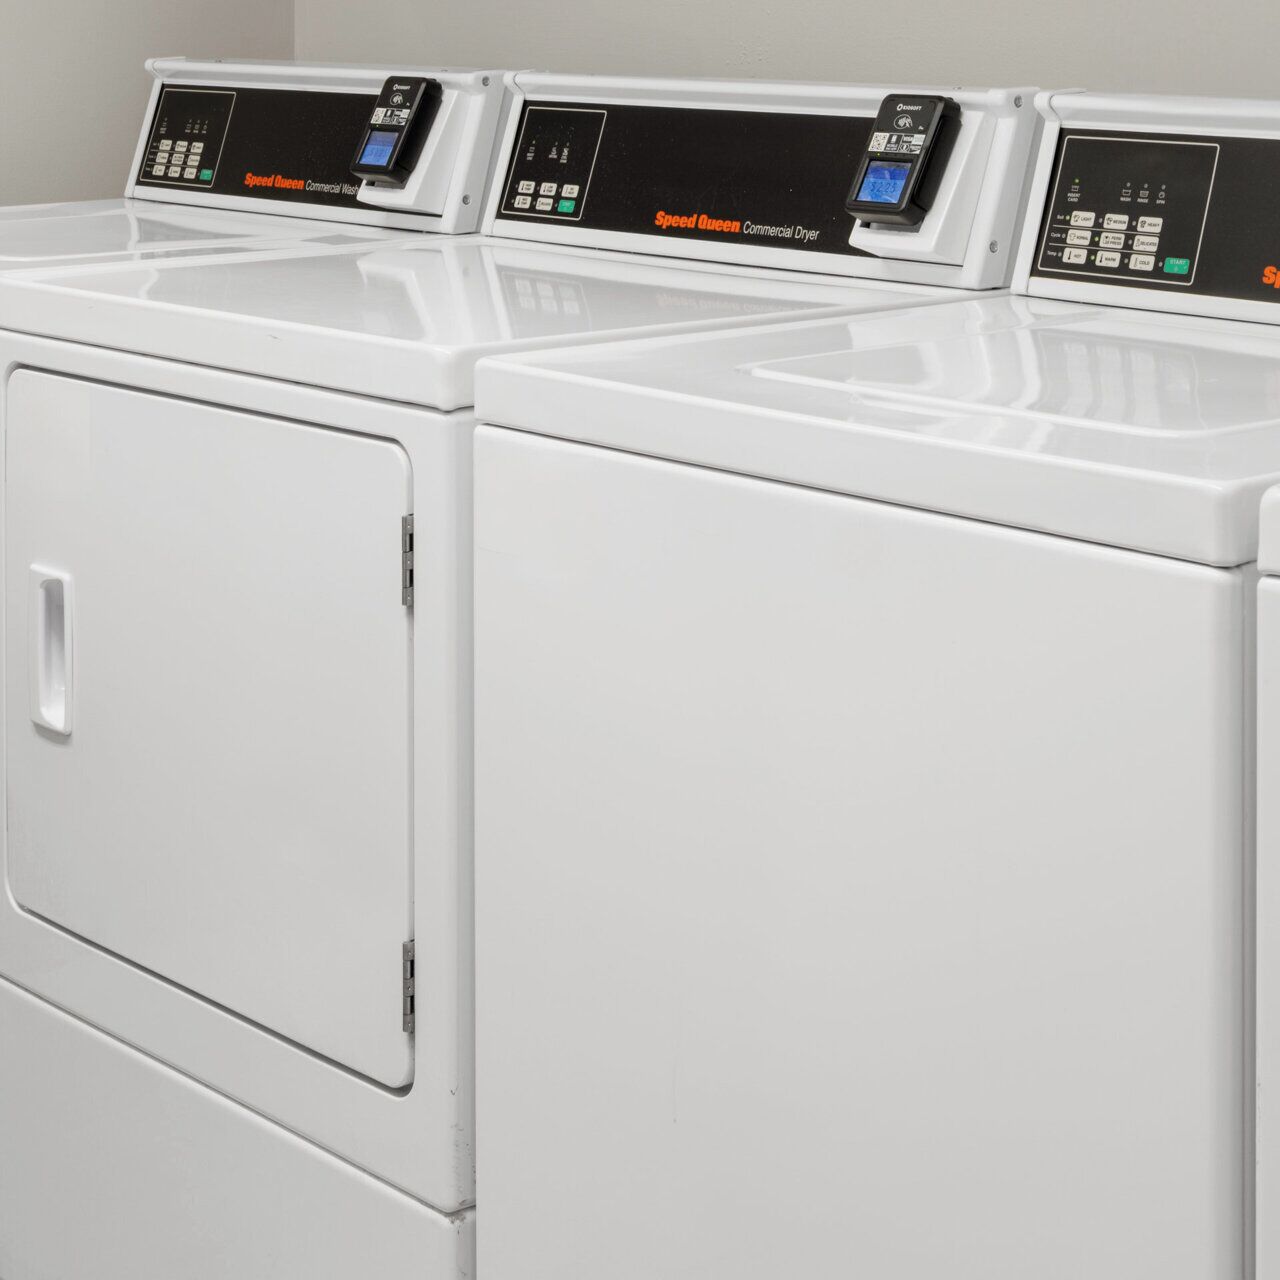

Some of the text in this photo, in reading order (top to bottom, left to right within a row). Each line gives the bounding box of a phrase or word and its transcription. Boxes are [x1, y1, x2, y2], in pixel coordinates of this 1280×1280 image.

[244, 173, 274, 188] Speed
[274, 176, 305, 190] Queen
[306, 180, 342, 194] Commercial
[654, 210, 820, 243] Speed Queen Commercial Dryer
